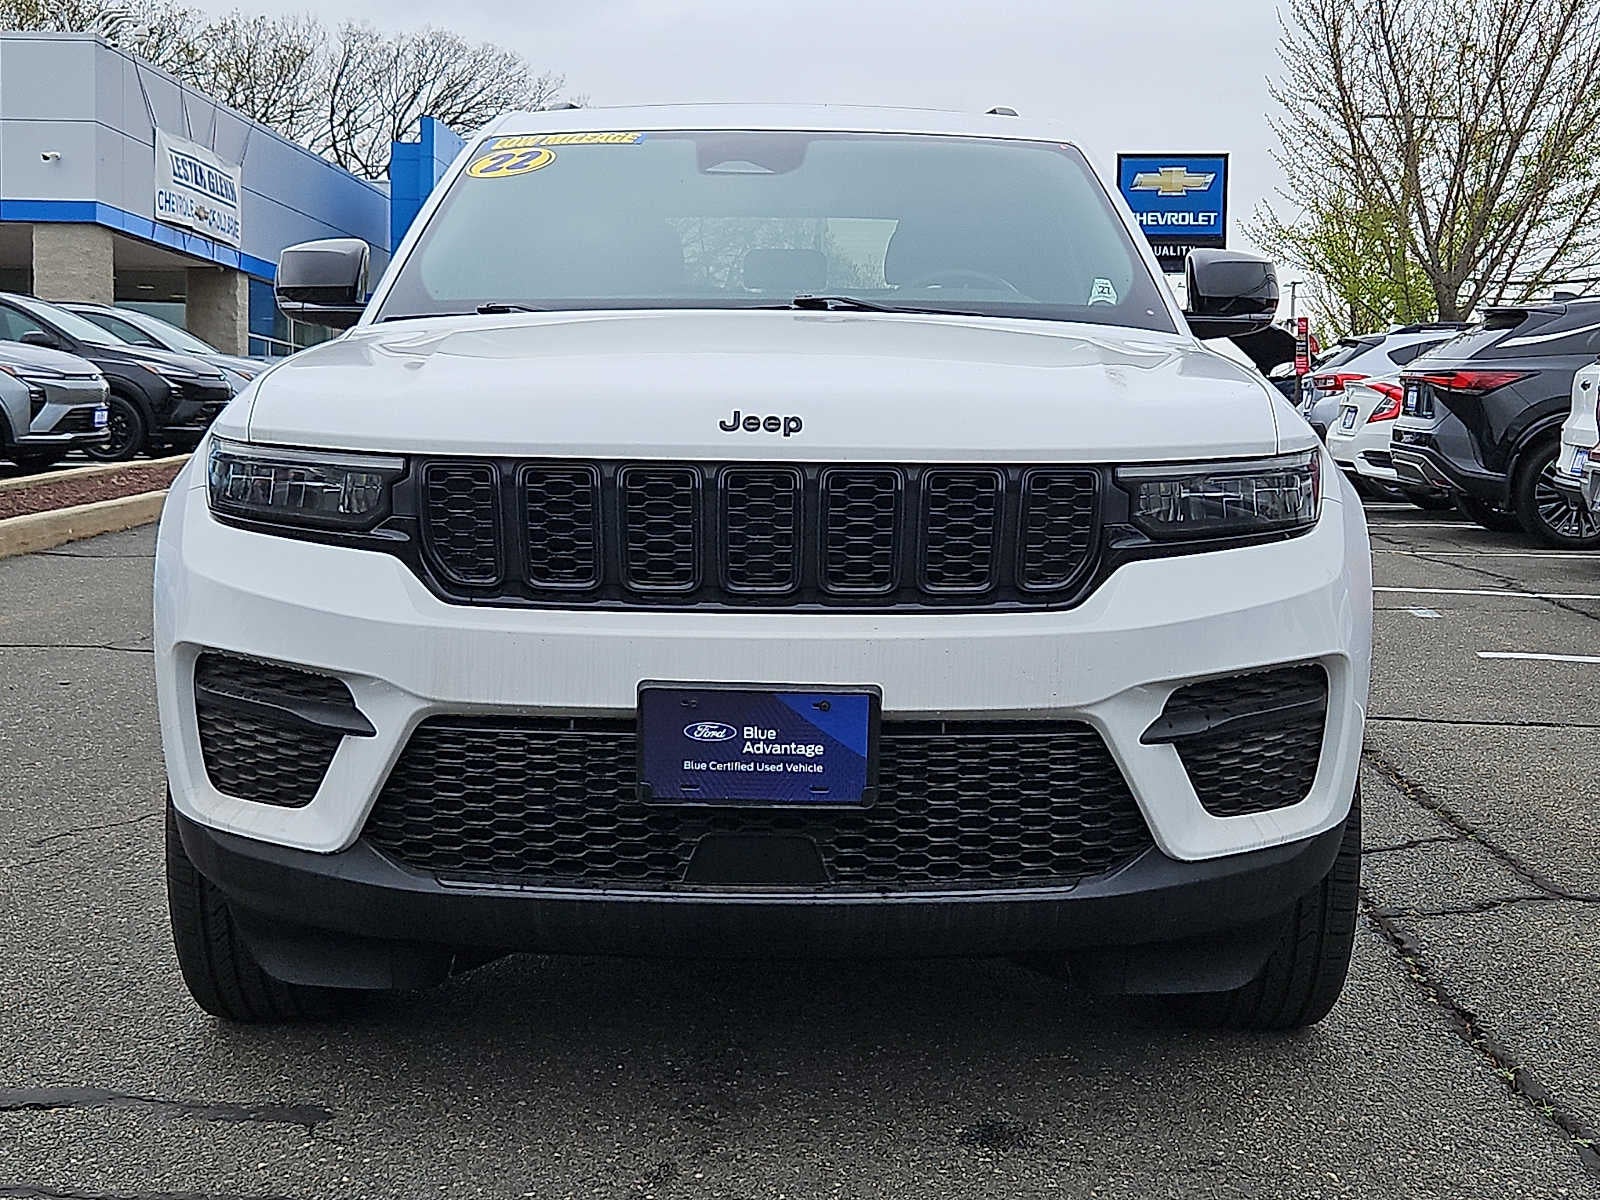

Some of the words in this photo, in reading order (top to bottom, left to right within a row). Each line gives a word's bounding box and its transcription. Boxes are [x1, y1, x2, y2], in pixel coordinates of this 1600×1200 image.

[541, 132, 641, 145] MILEAGE
[480, 150, 542, 173] 22
[1153, 245, 1196, 256] UALIT
[719, 410, 803, 437] Jeep
[693, 725, 727, 738] Ford
[743, 726, 777, 740] Blue
[742, 741, 824, 758] Advantage
[683, 760, 707, 771] Blue
[708, 760, 755, 772] Certified
[756, 762, 784, 773] Used
[785, 763, 824, 774] Vehicle
